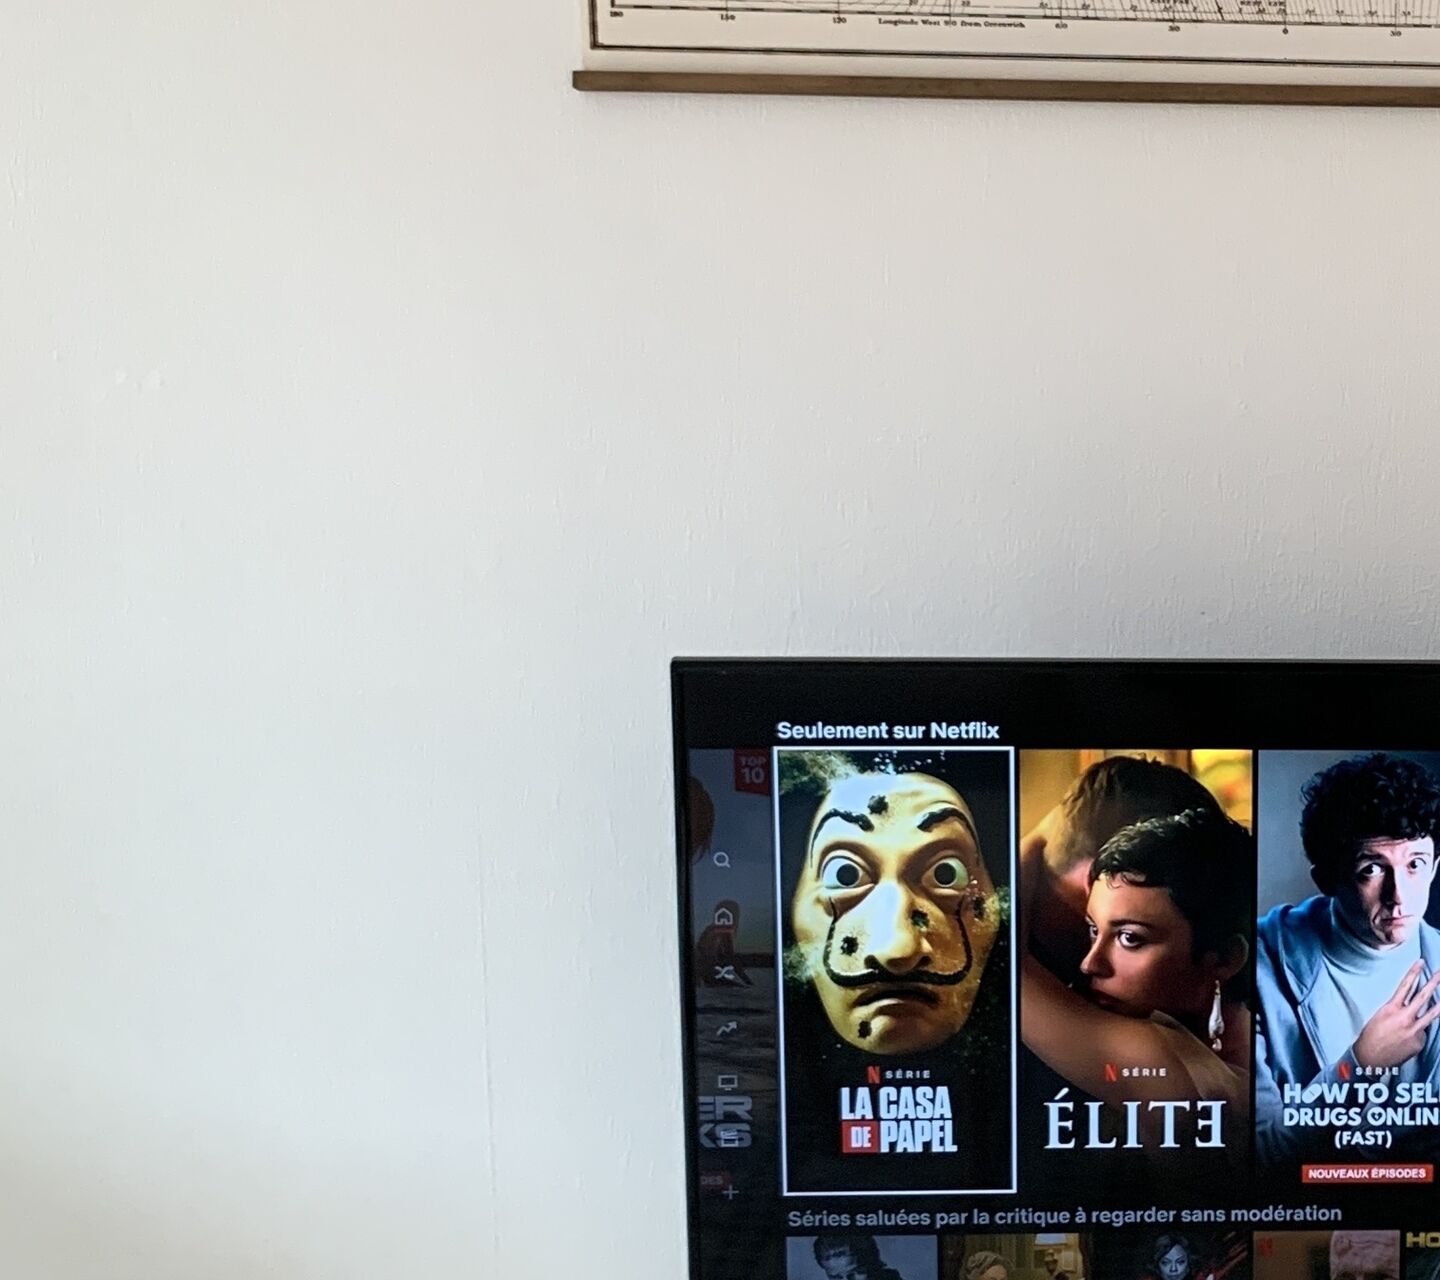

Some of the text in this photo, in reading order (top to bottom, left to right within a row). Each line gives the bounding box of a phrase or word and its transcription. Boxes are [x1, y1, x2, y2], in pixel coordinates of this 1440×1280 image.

[776, 722, 1000, 739] Seulement sur Netflix
[740, 756, 766, 767] TOP
[742, 769, 764, 784] 10
[868, 1066, 931, 1084] N SÉRIE
[1104, 1064, 1167, 1082] N SÉRIE
[1338, 1062, 1399, 1080] N SÉRIE
[840, 1086, 951, 1119] LA CASA
[1284, 1083, 1349, 1105] HOW
[1354, 1083, 1389, 1103] TO
[1284, 1107, 1362, 1127] DRUGS
[850, 1120, 958, 1152] DE PAPEL
[1334, 1130, 1392, 1149] (FAST)
[1308, 1167, 1426, 1179] NOUVEAUX ÉPISODES
[788, 1204, 1342, 1229] Séries saluées par la critique à regarder sans modération
